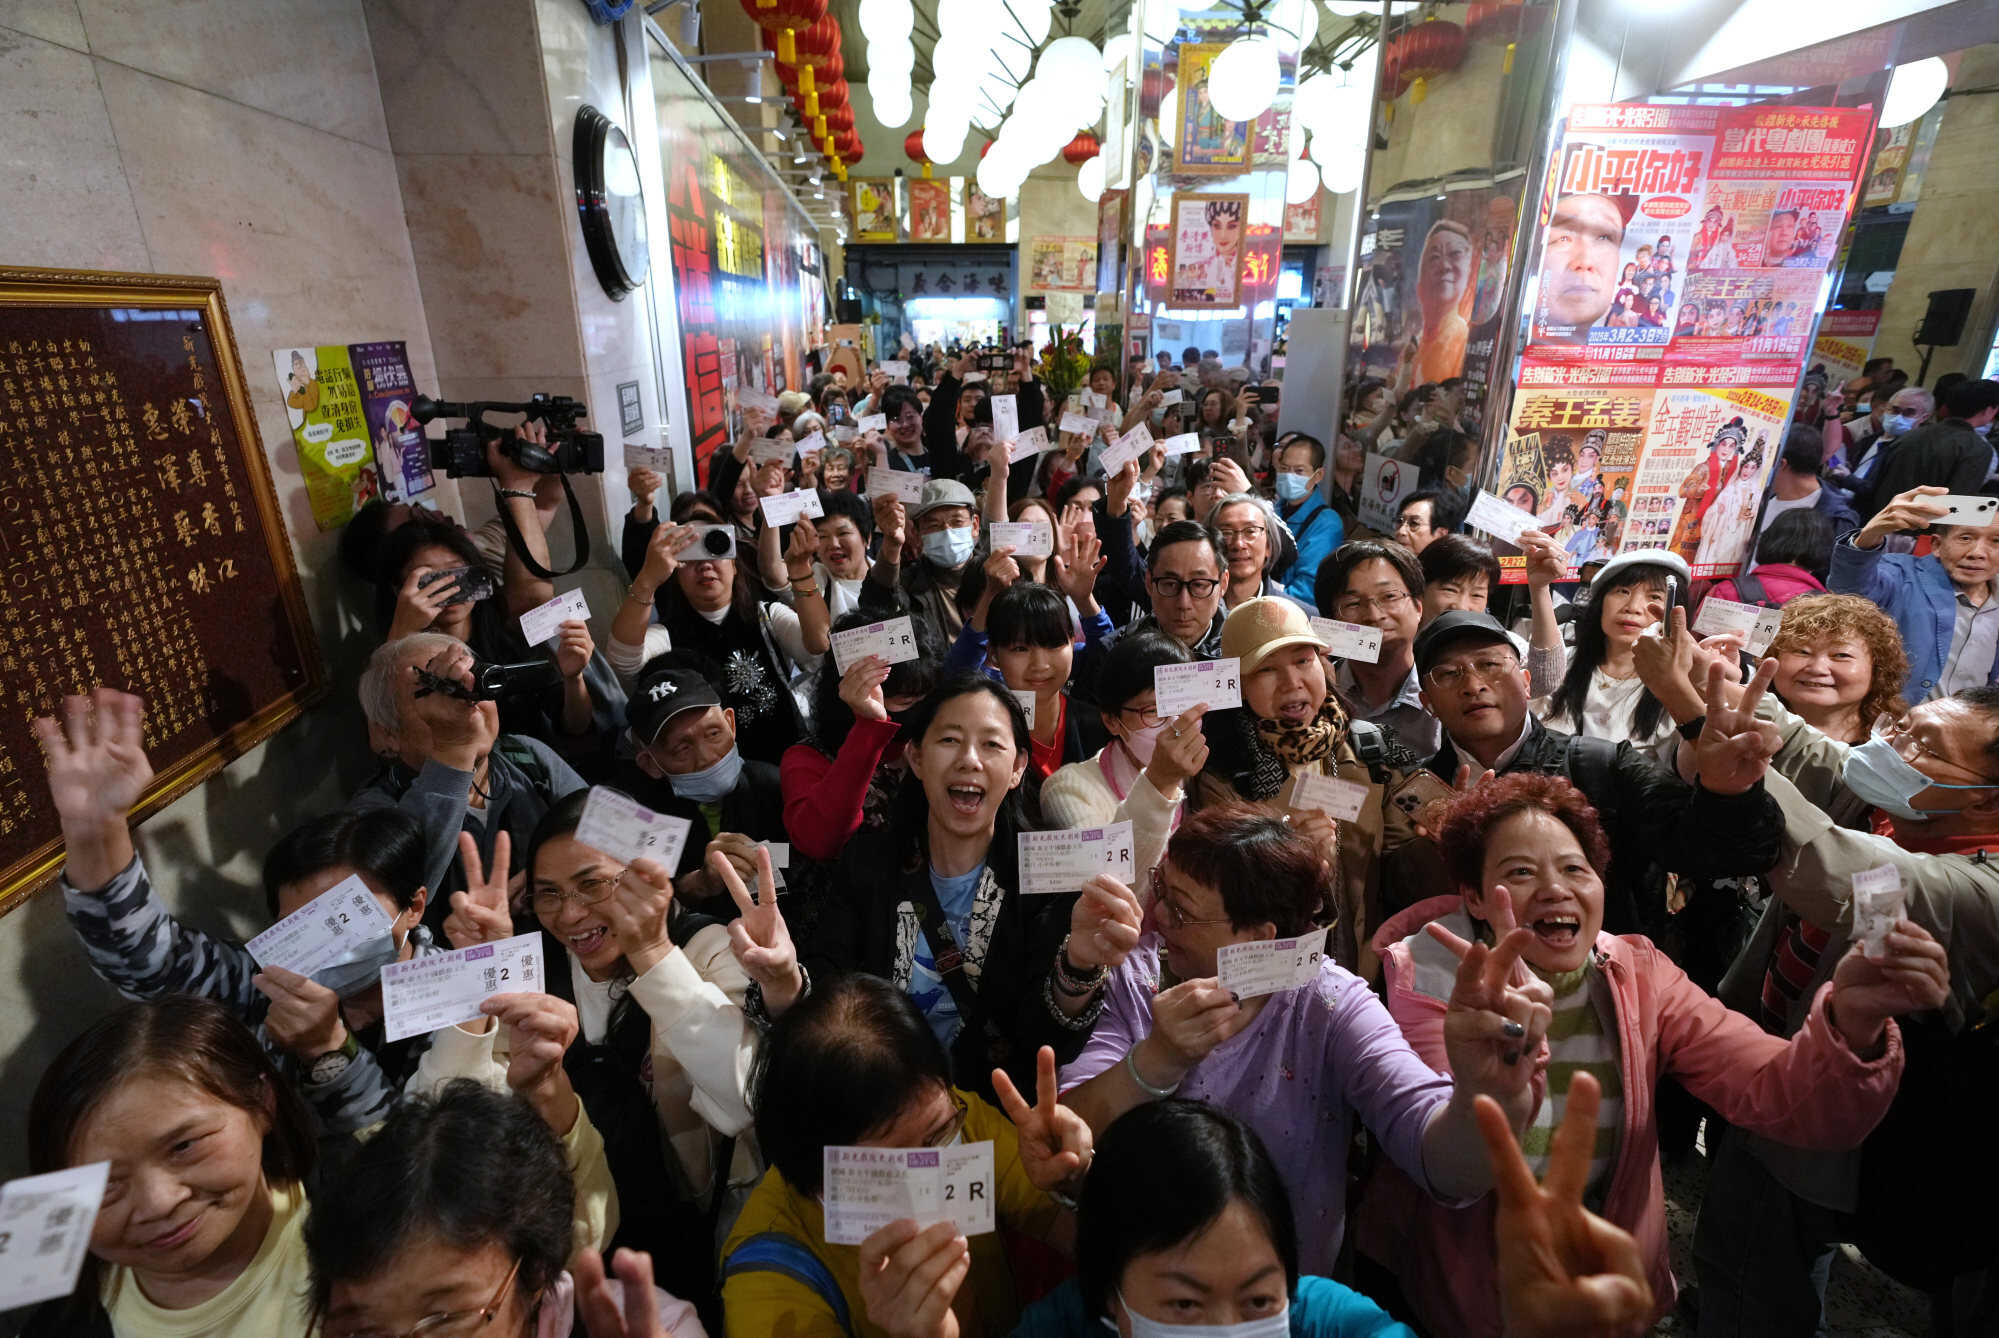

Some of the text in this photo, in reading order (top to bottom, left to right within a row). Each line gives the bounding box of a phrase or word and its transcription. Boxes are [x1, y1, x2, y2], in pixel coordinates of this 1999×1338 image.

[1565, 147, 1703, 194] 小平你好
[1778, 189, 1845, 210] 小平你好
[1520, 396, 1641, 428] 秦王孟姜
[1651, 396, 1721, 447] 金玉觀世音
[576, 602, 584, 610] R
[1764, 625, 1773, 633] R
[888, 635, 910, 646] 2 R
[1368, 642, 1376, 650] R
[648, 681, 678, 702] NY
[1216, 680, 1236, 689] 2 R
[1024, 707, 1031, 715] R
[648, 836, 656, 846] 2
[1106, 848, 1129, 863] 2 R
[338, 912, 350, 924] 2
[1296, 952, 1318, 967] 2 R
[500, 968, 510, 981] 2
[520, 954, 536, 982] 優惠
[484, 966, 498, 992] 優惠
[945, 1182, 984, 1200] 2 R
